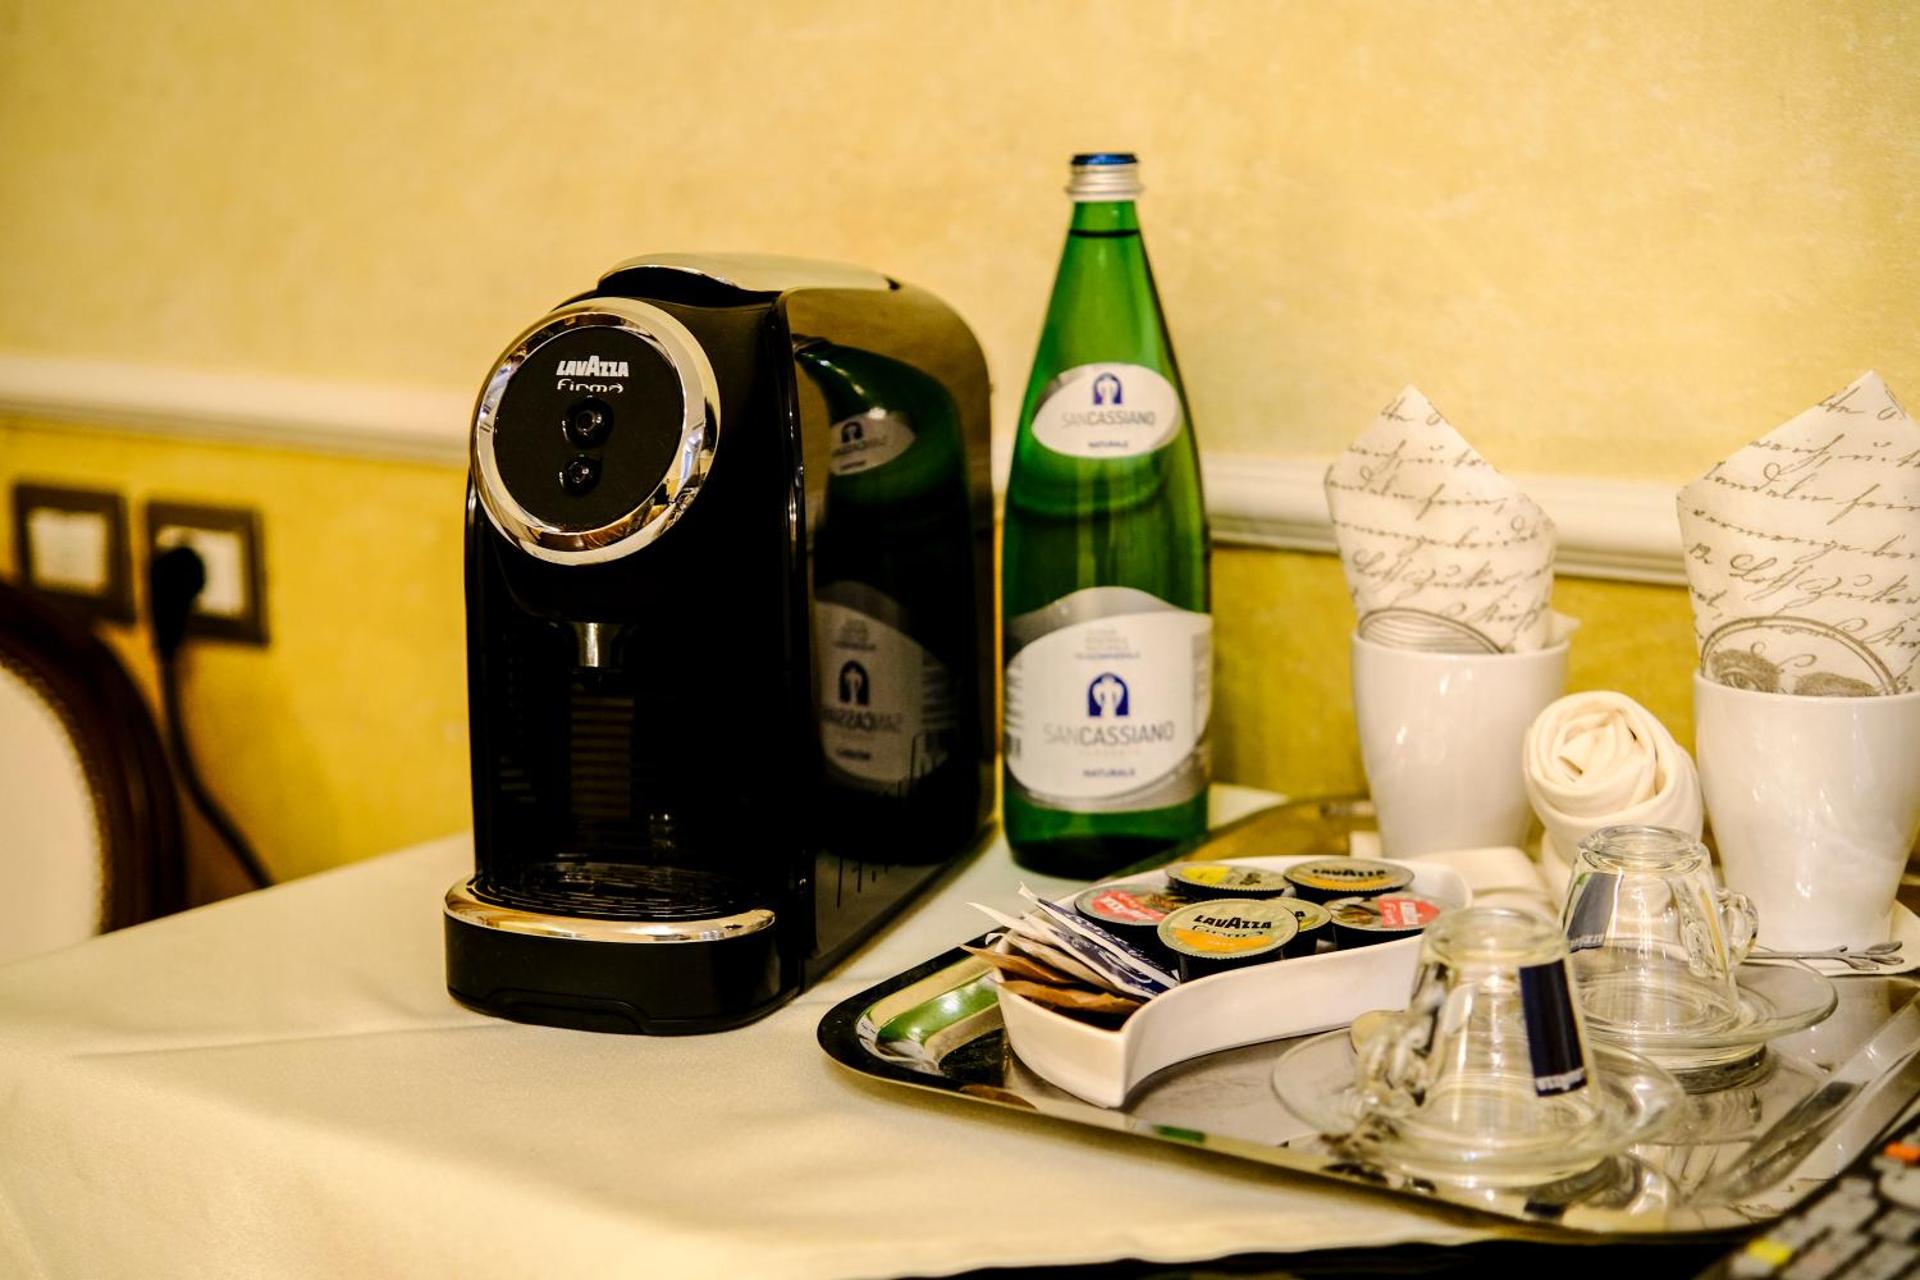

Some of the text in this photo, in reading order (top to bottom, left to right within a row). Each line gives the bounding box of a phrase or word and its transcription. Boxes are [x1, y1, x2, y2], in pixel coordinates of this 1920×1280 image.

[556, 355, 629, 377] LAVAZZA
[1042, 721, 1175, 747] SANCASSIANO
[1193, 914, 1272, 929] LAVAZZA
